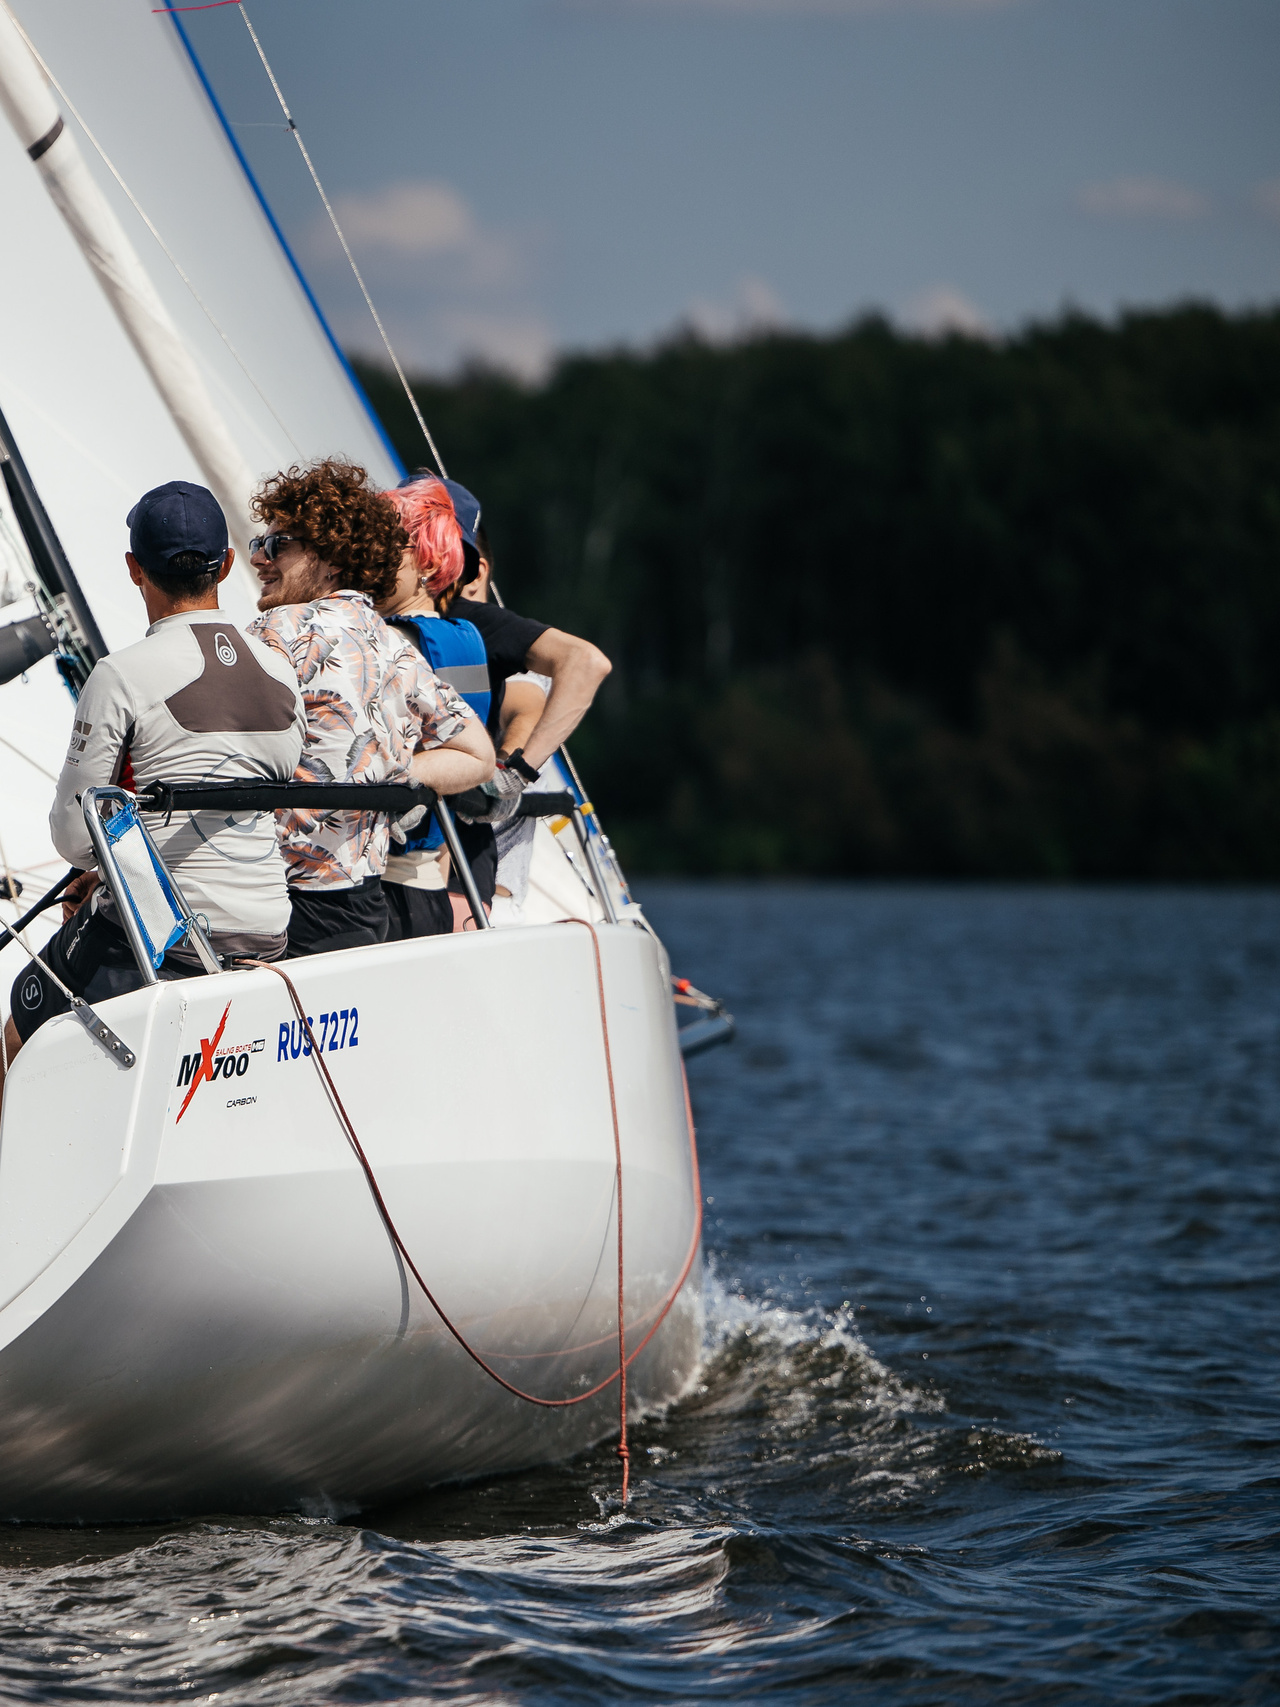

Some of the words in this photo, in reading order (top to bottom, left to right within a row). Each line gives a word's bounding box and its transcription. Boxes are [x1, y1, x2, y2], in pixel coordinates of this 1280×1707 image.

[277, 1015, 314, 1062] RUS
[320, 1007, 359, 1054] 7272
[226, 1096, 258, 1109] CARBON
